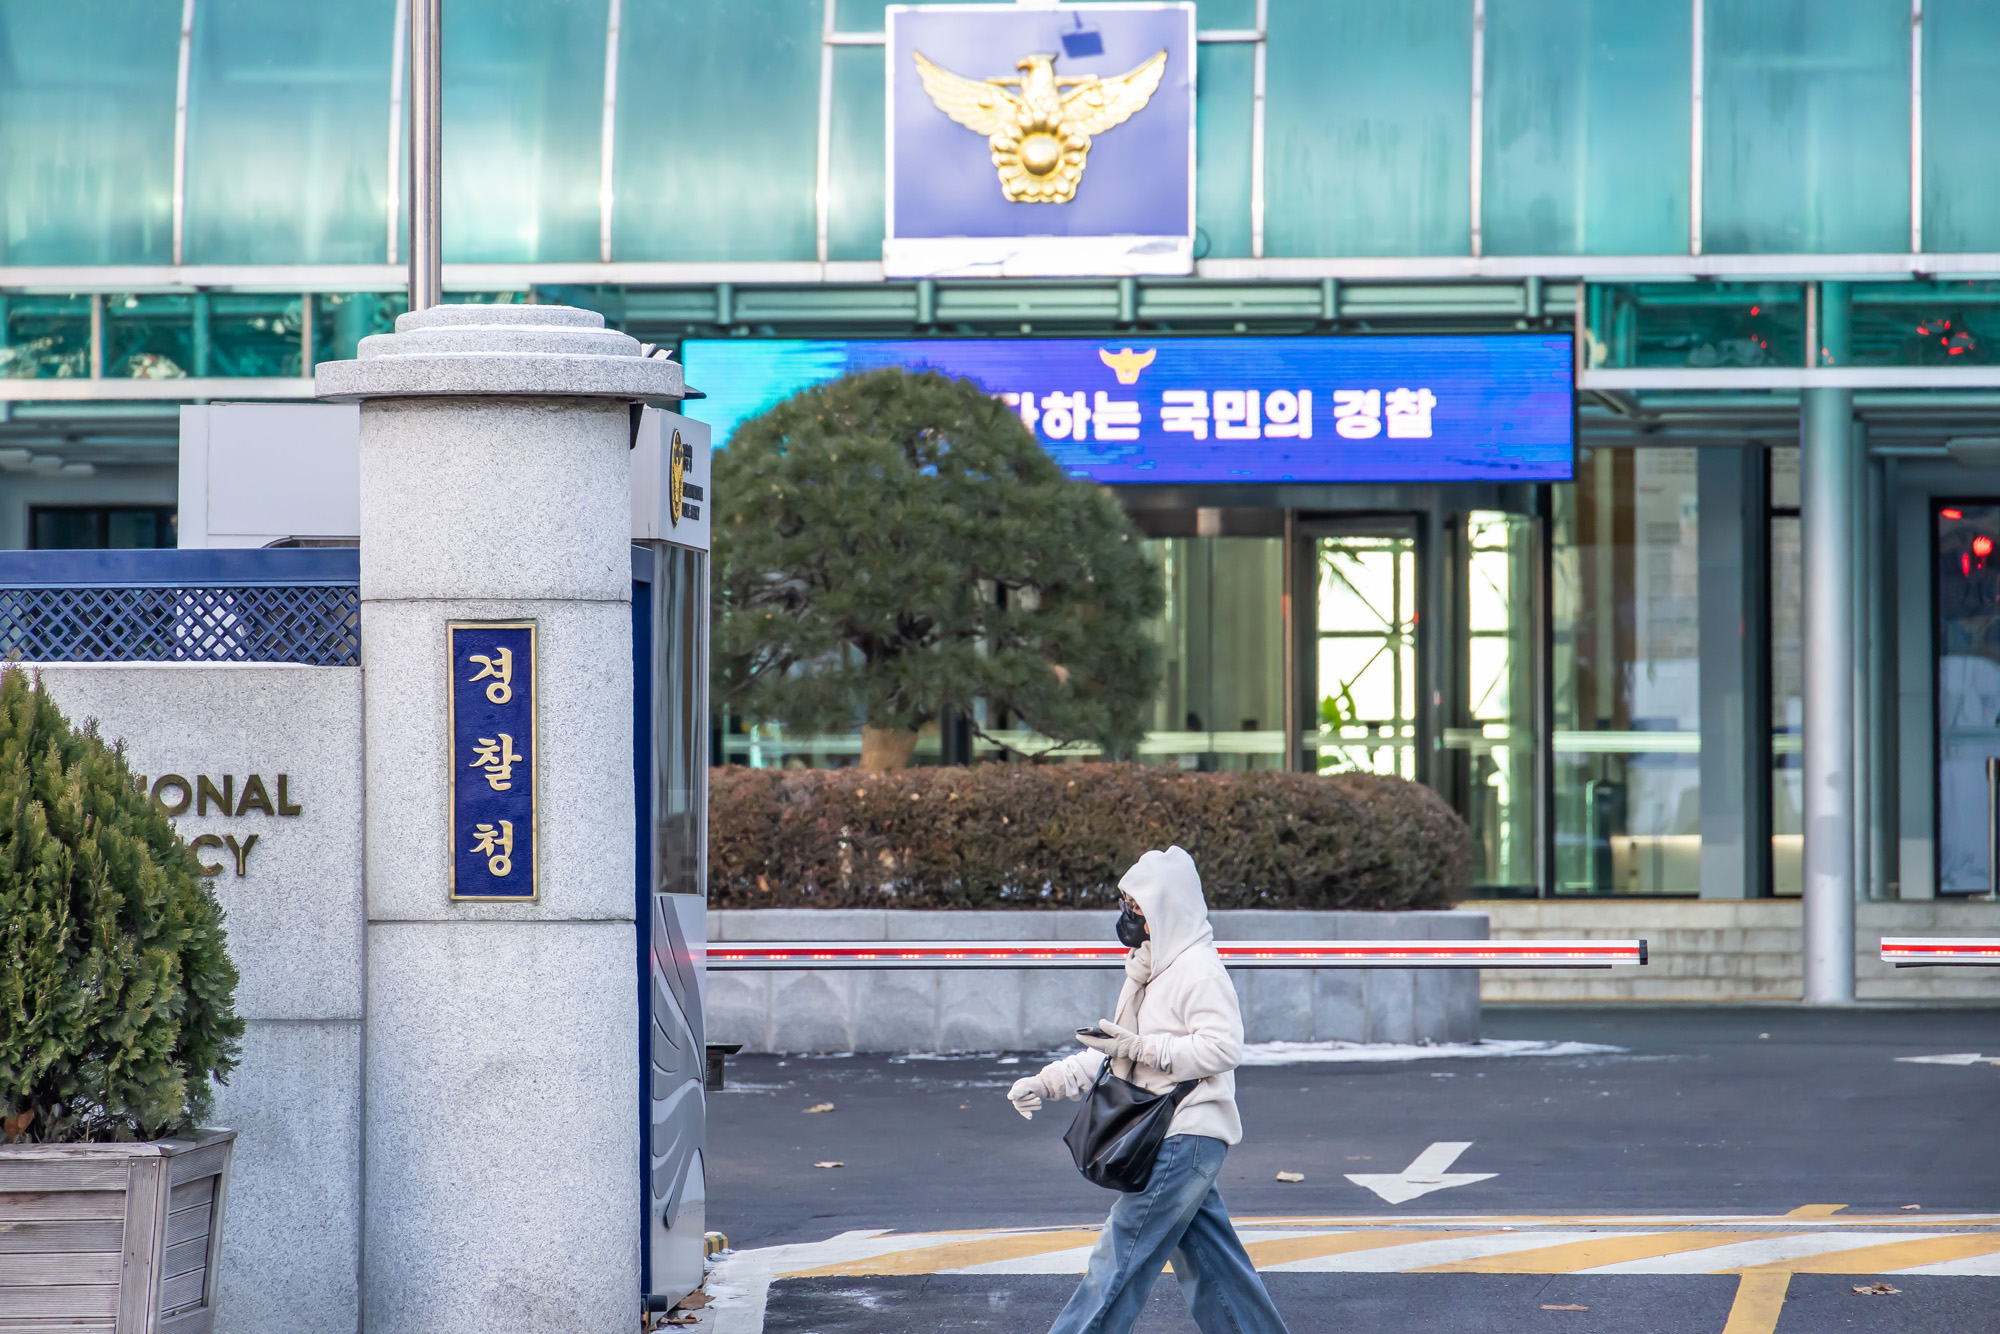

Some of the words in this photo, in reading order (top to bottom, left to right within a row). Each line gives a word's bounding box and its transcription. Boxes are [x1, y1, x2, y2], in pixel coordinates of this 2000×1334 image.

[1160, 389, 1313, 440] 국민의
[1333, 387, 1437, 439] 경찰
[468, 647, 523, 877] 경찰청
